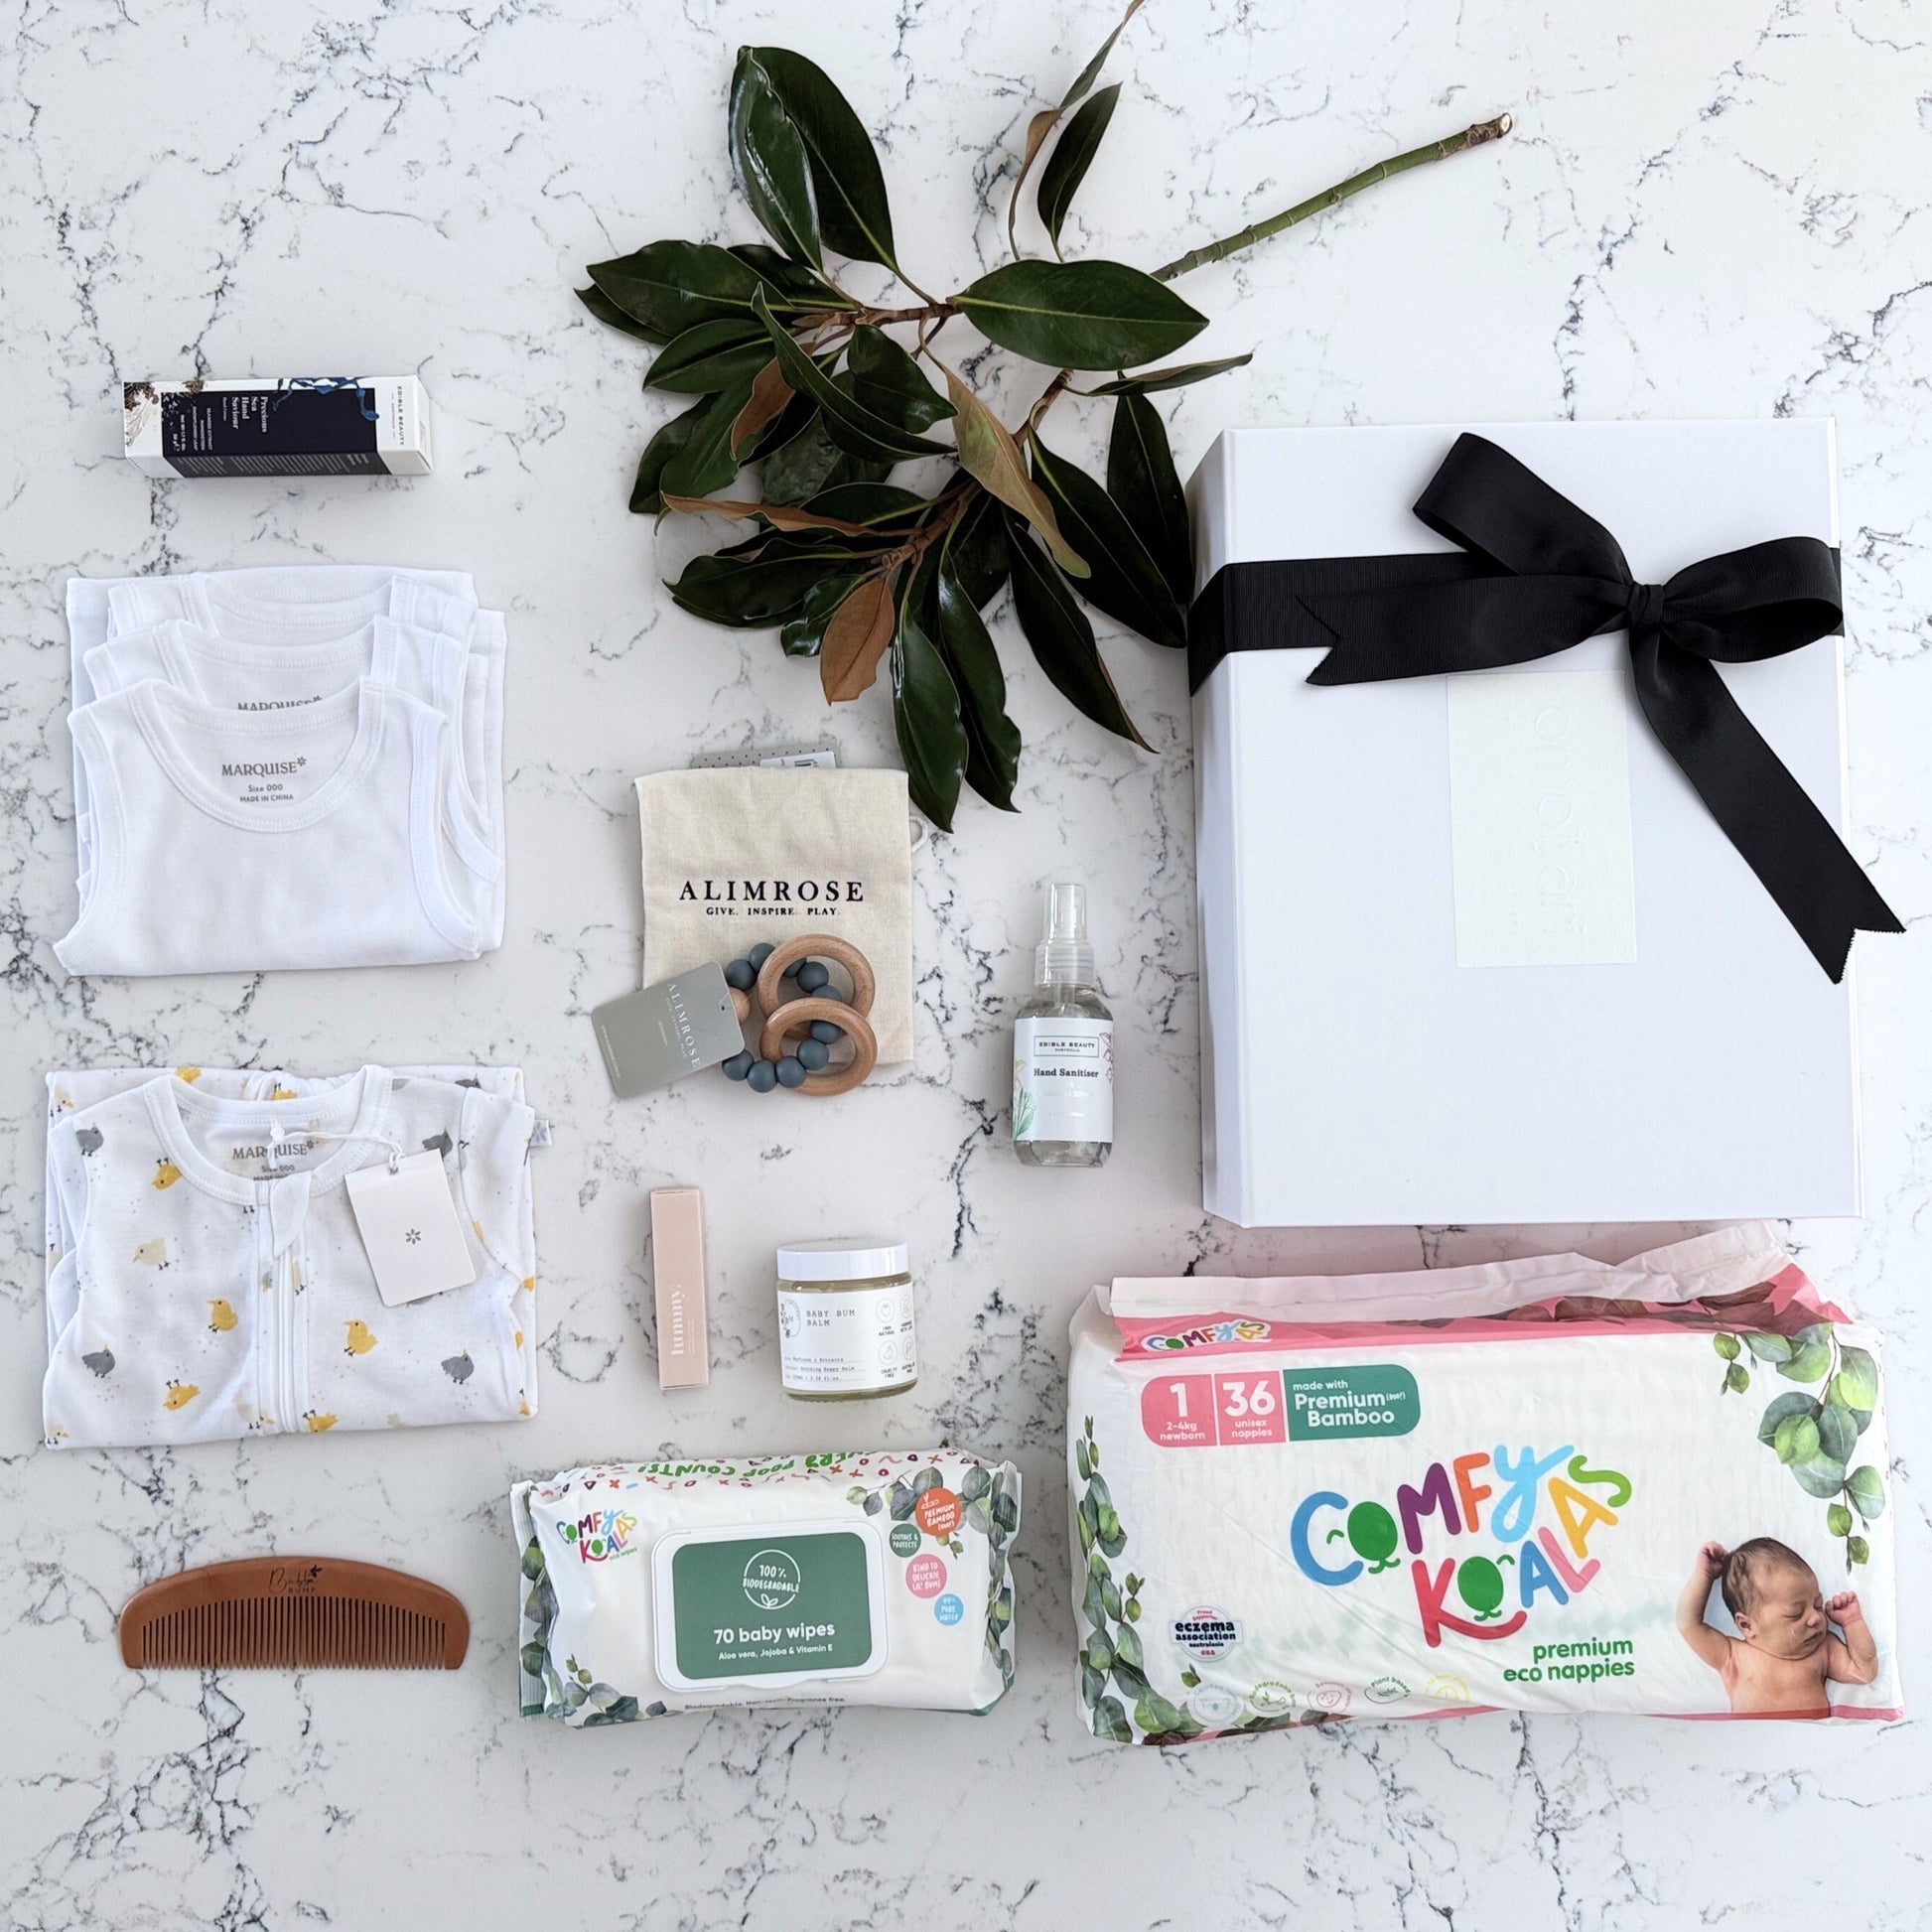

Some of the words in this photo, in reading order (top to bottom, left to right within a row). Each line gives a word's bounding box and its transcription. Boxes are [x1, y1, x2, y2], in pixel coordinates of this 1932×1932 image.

[241, 397, 250, 419] Hand
[238, 698, 315, 711] MARQUI
[221, 761, 298, 777] MARQUISE
[679, 880, 864, 901] ALIMROSE
[667, 983, 701, 1068] ALIMROSE
[1058, 1068, 1099, 1077] Sanitiser
[232, 1144, 308, 1160] MARUISE
[1293, 1381, 1323, 1391] made
[1324, 1380, 1348, 1390] with
[1170, 1382, 1188, 1418] 1
[1222, 1380, 1276, 1417] 36
[1295, 1390, 1386, 1410] Premium
[1235, 1419, 1267, 1428] unisex
[1307, 1408, 1395, 1428] Bamboo
[1166, 1422, 1197, 1432] 2-4kg
[1231, 1428, 1273, 1439] nappies
[1160, 1432, 1205, 1441] newborn
[637, 1462, 736, 1476] COUNTS!
[743, 1459, 794, 1477] POOP
[924, 1502, 955, 1519] PREMIUM
[926, 1511, 955, 1527] BAMBOO
[759, 1565, 786, 1578] 100%
[913, 1563, 929, 1573] KIND
[912, 1571, 939, 1582] DELICATE
[743, 1578, 799, 1592] BIODEGRADABLE
[713, 1628, 735, 1644] 70
[739, 1626, 782, 1644] baby
[786, 1622, 836, 1641] wipes
[1174, 1621, 1235, 1632] eczema
[1175, 1631, 1236, 1641] association
[719, 1651, 737, 1660] Aloe
[760, 1648, 787, 1658] Jojoba
[796, 1644, 826, 1654] Vitamin
[1533, 1636, 1634, 1664] premium
[1503, 1666, 1544, 1682] eco
[1547, 1658, 1635, 1683] nappies
[1370, 1677, 1390, 1688] Plant
